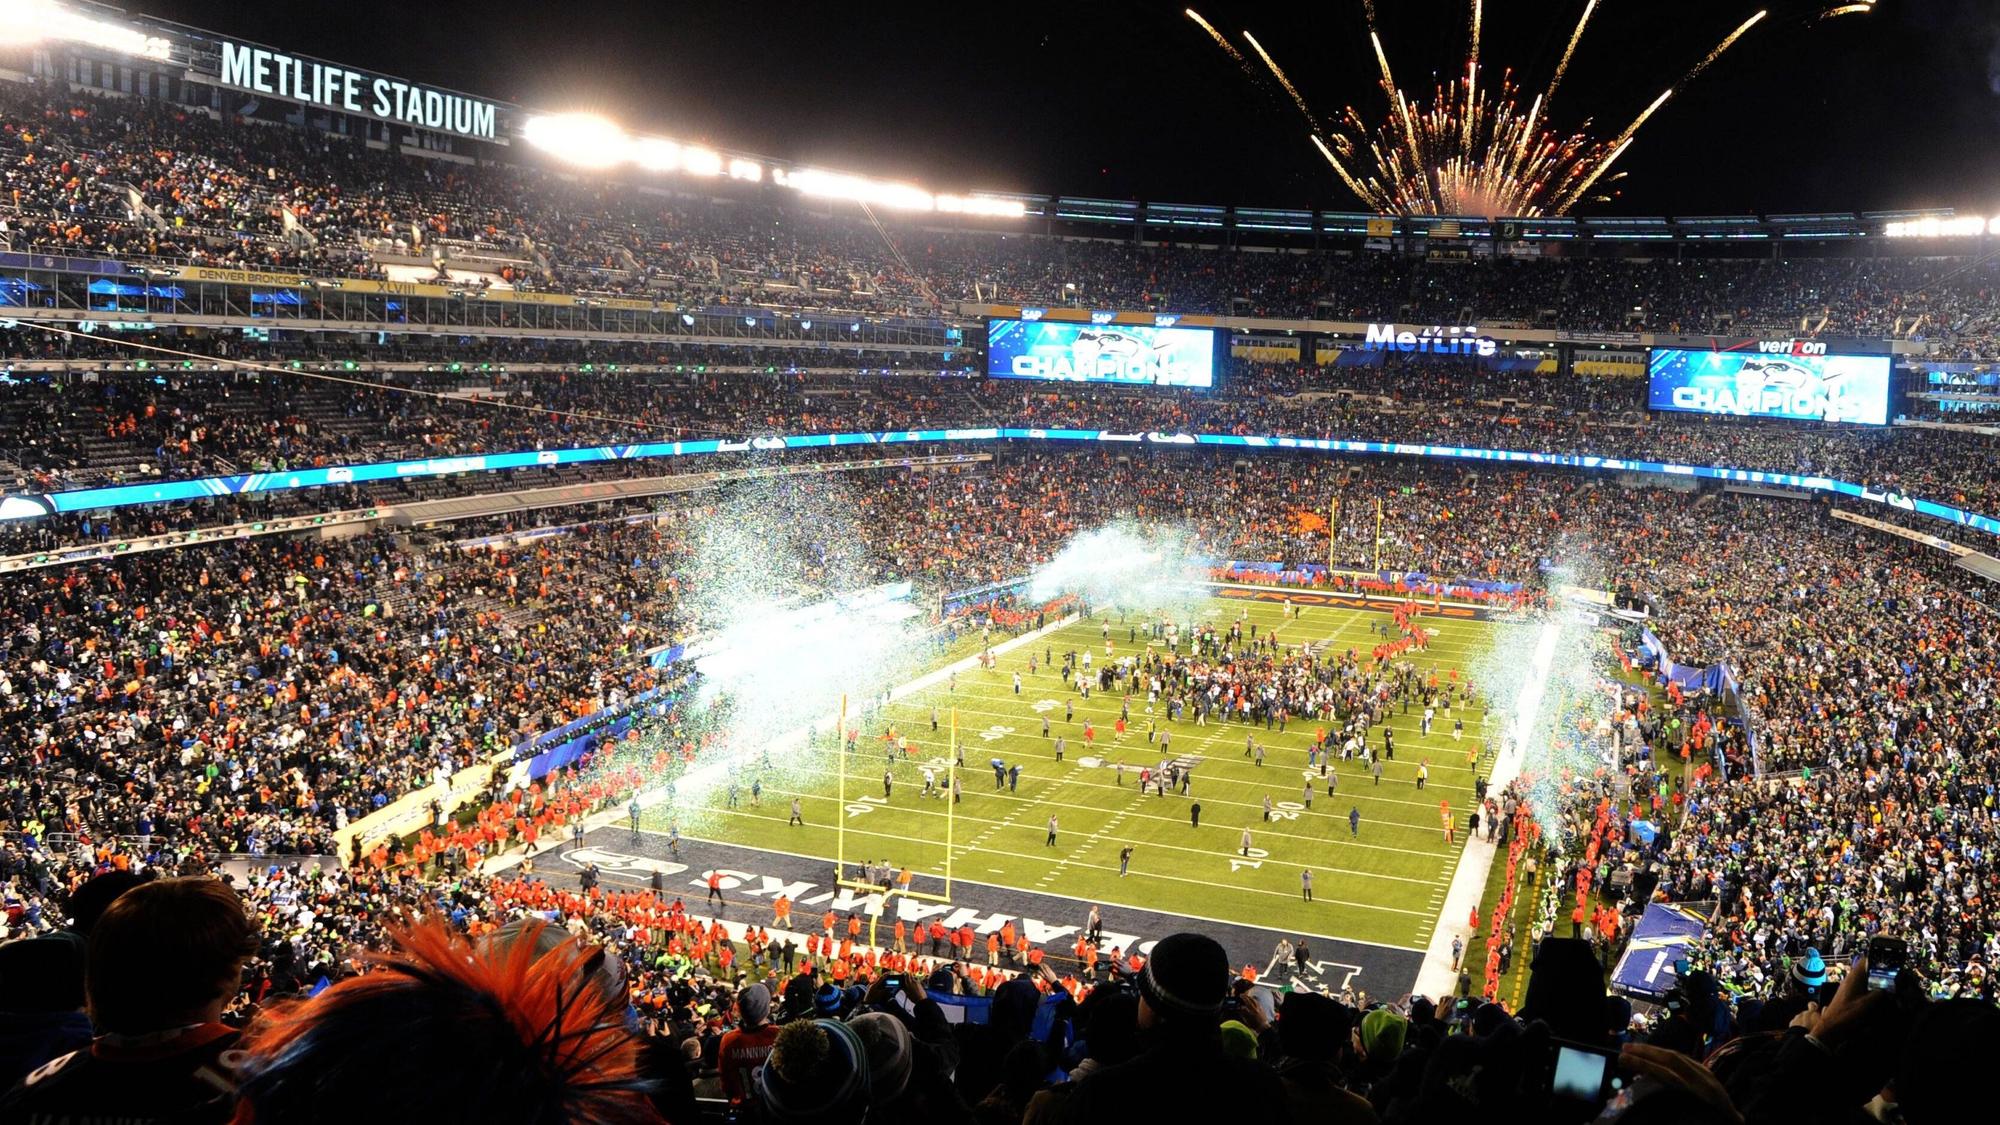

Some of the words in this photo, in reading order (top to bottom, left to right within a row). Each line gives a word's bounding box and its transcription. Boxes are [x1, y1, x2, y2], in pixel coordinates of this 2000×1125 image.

[221, 41, 362, 112] METLIFE
[372, 78, 495, 138] STADIUM
[199, 269, 245, 282] DENVER
[247, 273, 300, 285] BRONCOS
[1021, 309, 1043, 321] SAP
[1092, 312, 1113, 325] SAP
[1155, 315, 1176, 327] SAP
[1363, 323, 1497, 356] MetLife
[1759, 338, 1827, 358] verizon
[1011, 353, 1192, 385] CHAMPIONS
[1672, 385, 1862, 422] CHAMPIONS
